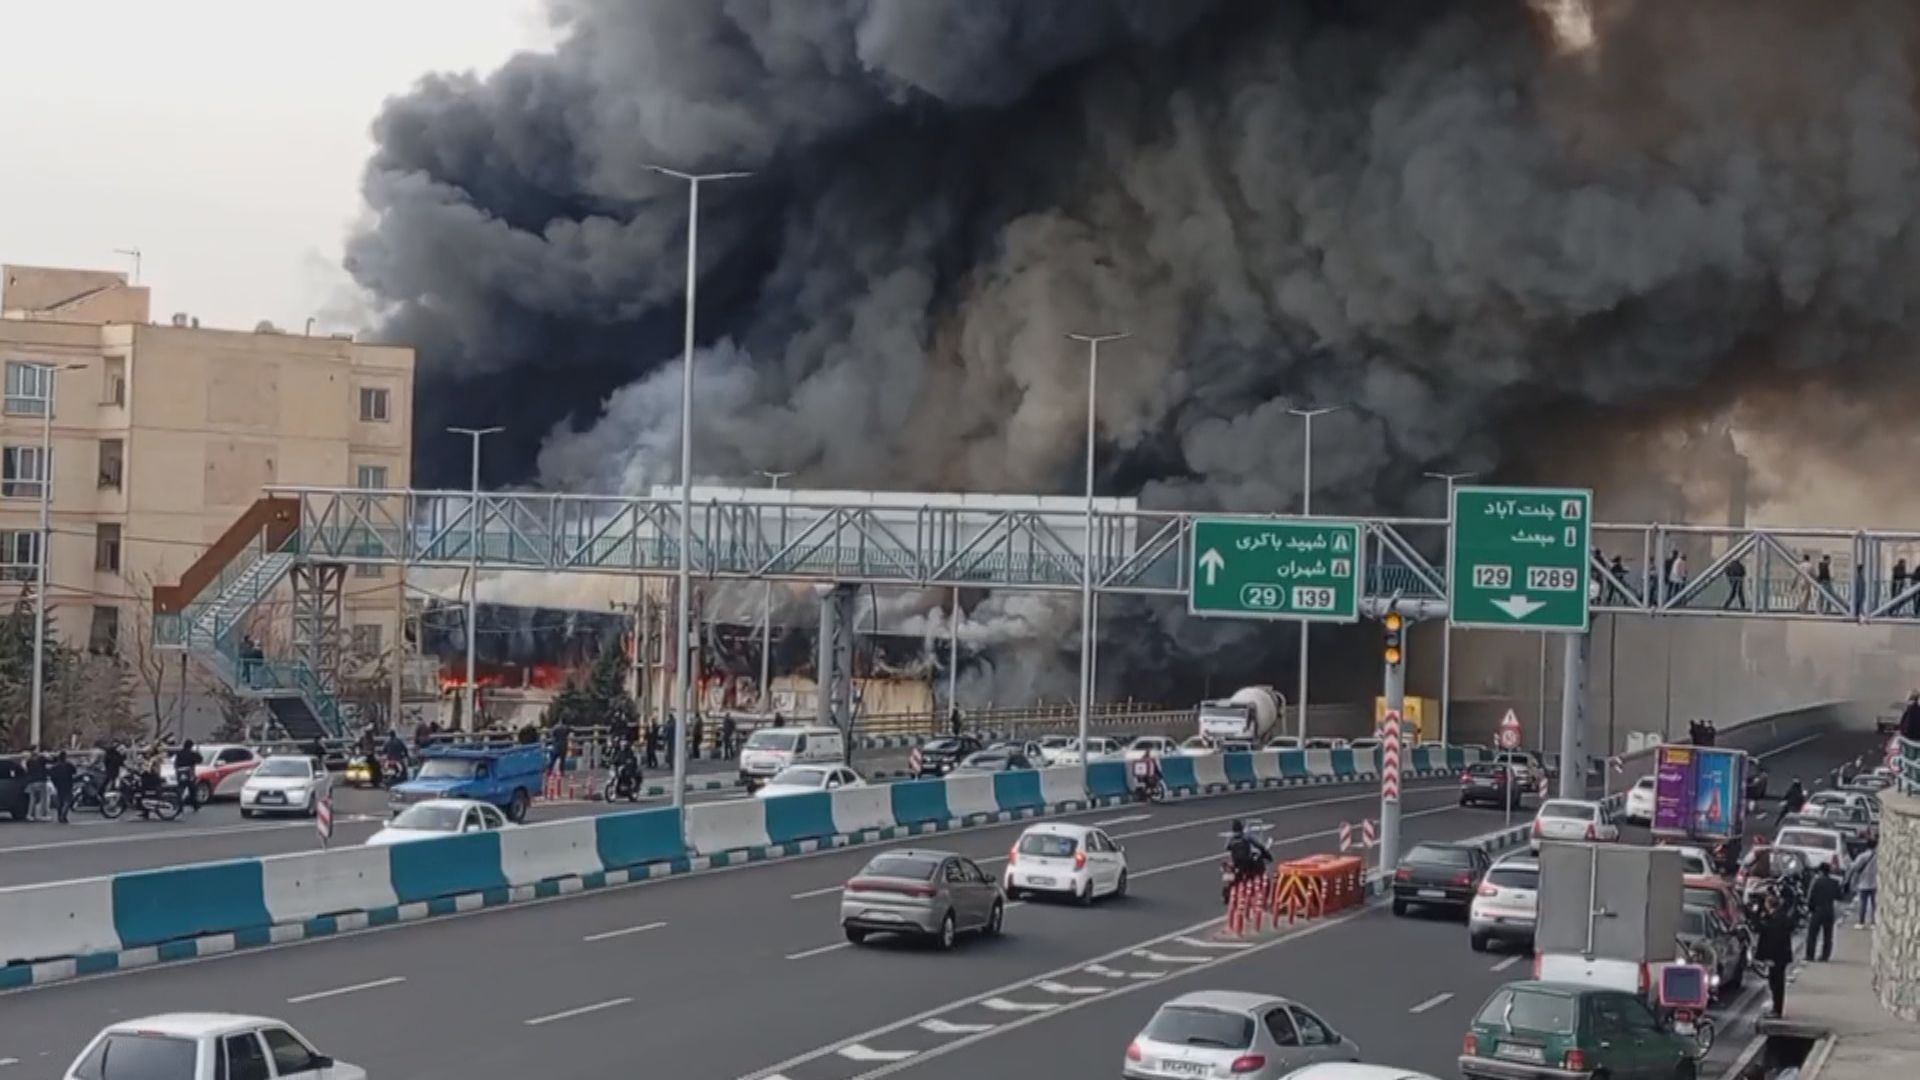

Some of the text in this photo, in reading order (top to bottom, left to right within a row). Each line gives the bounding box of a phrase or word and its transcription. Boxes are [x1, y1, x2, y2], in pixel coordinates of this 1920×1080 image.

[1484, 500, 1517, 520] آباد
[1236, 532, 1328, 552] شهید باکری
[1510, 528, 1556, 548] مبعث
[1276, 560, 1327, 579] شهران
[1476, 568, 1576, 589] 129 1289
[1248, 587, 1331, 607] 29 139
